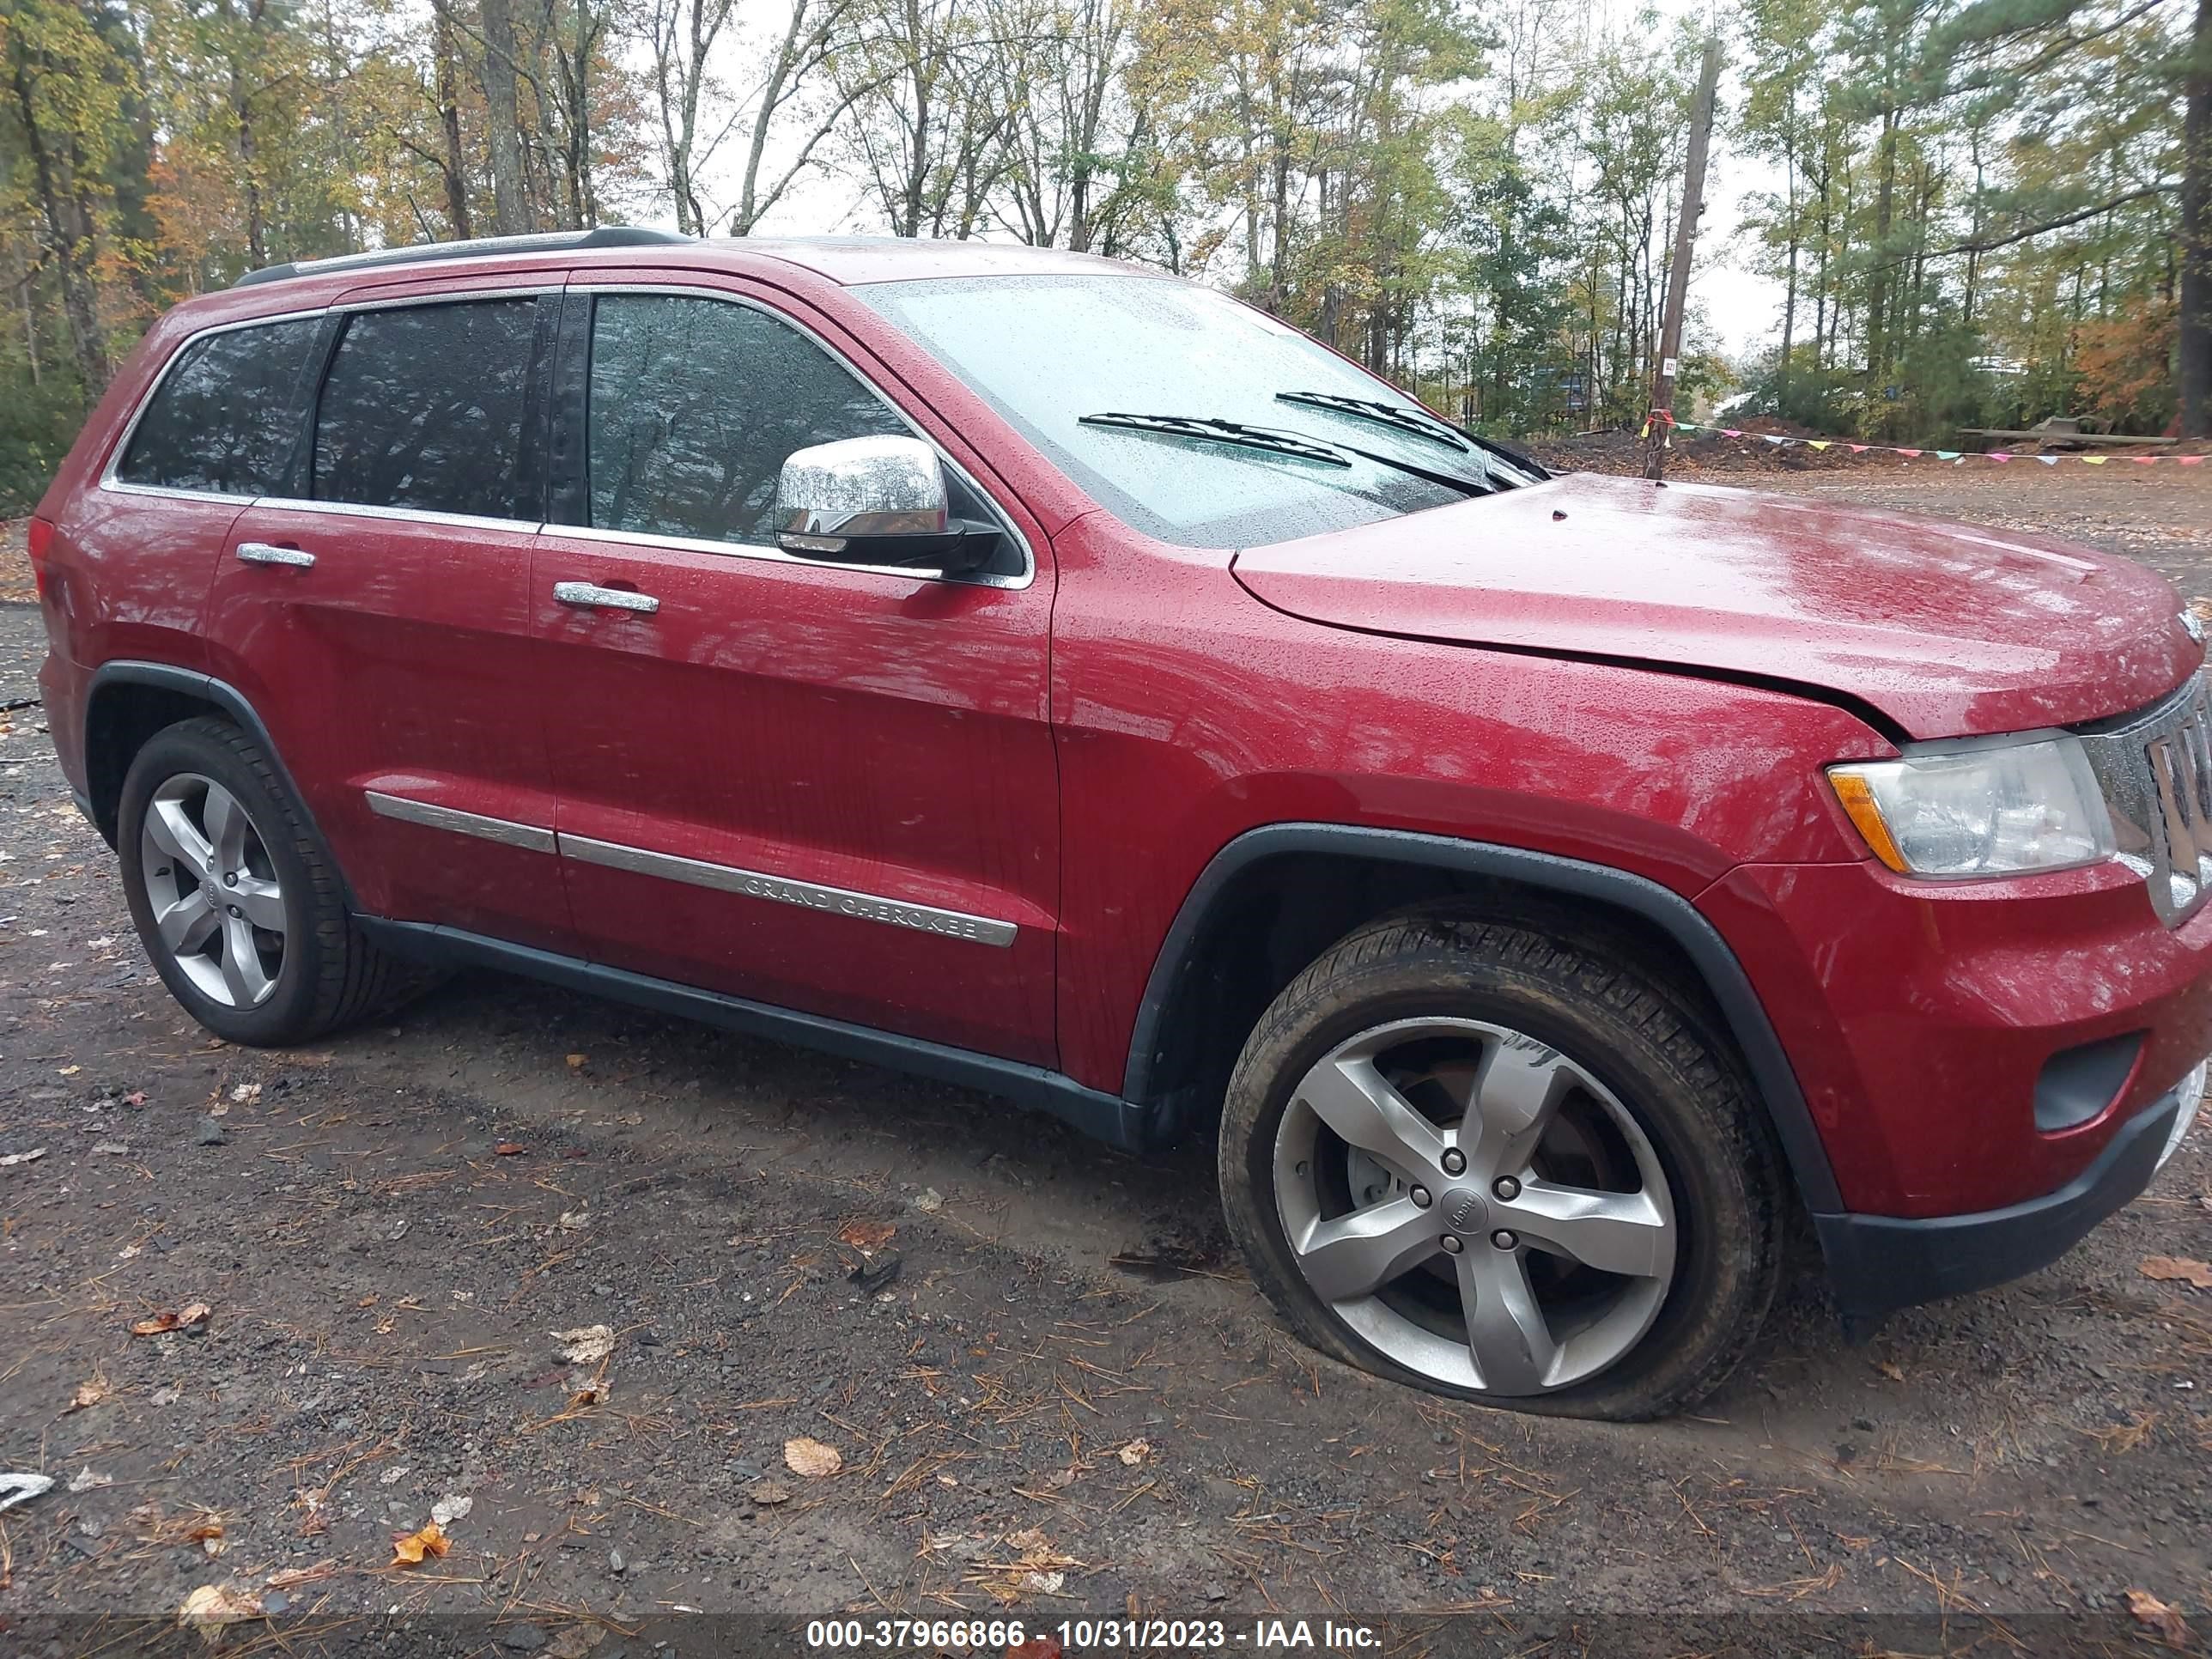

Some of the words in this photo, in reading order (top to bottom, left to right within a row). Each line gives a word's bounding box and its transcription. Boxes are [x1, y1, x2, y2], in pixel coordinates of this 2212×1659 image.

[744, 878, 830, 908] GRAND
[839, 899, 978, 939] CHEROKEE
[1451, 1195, 1476, 1227] Jeep
